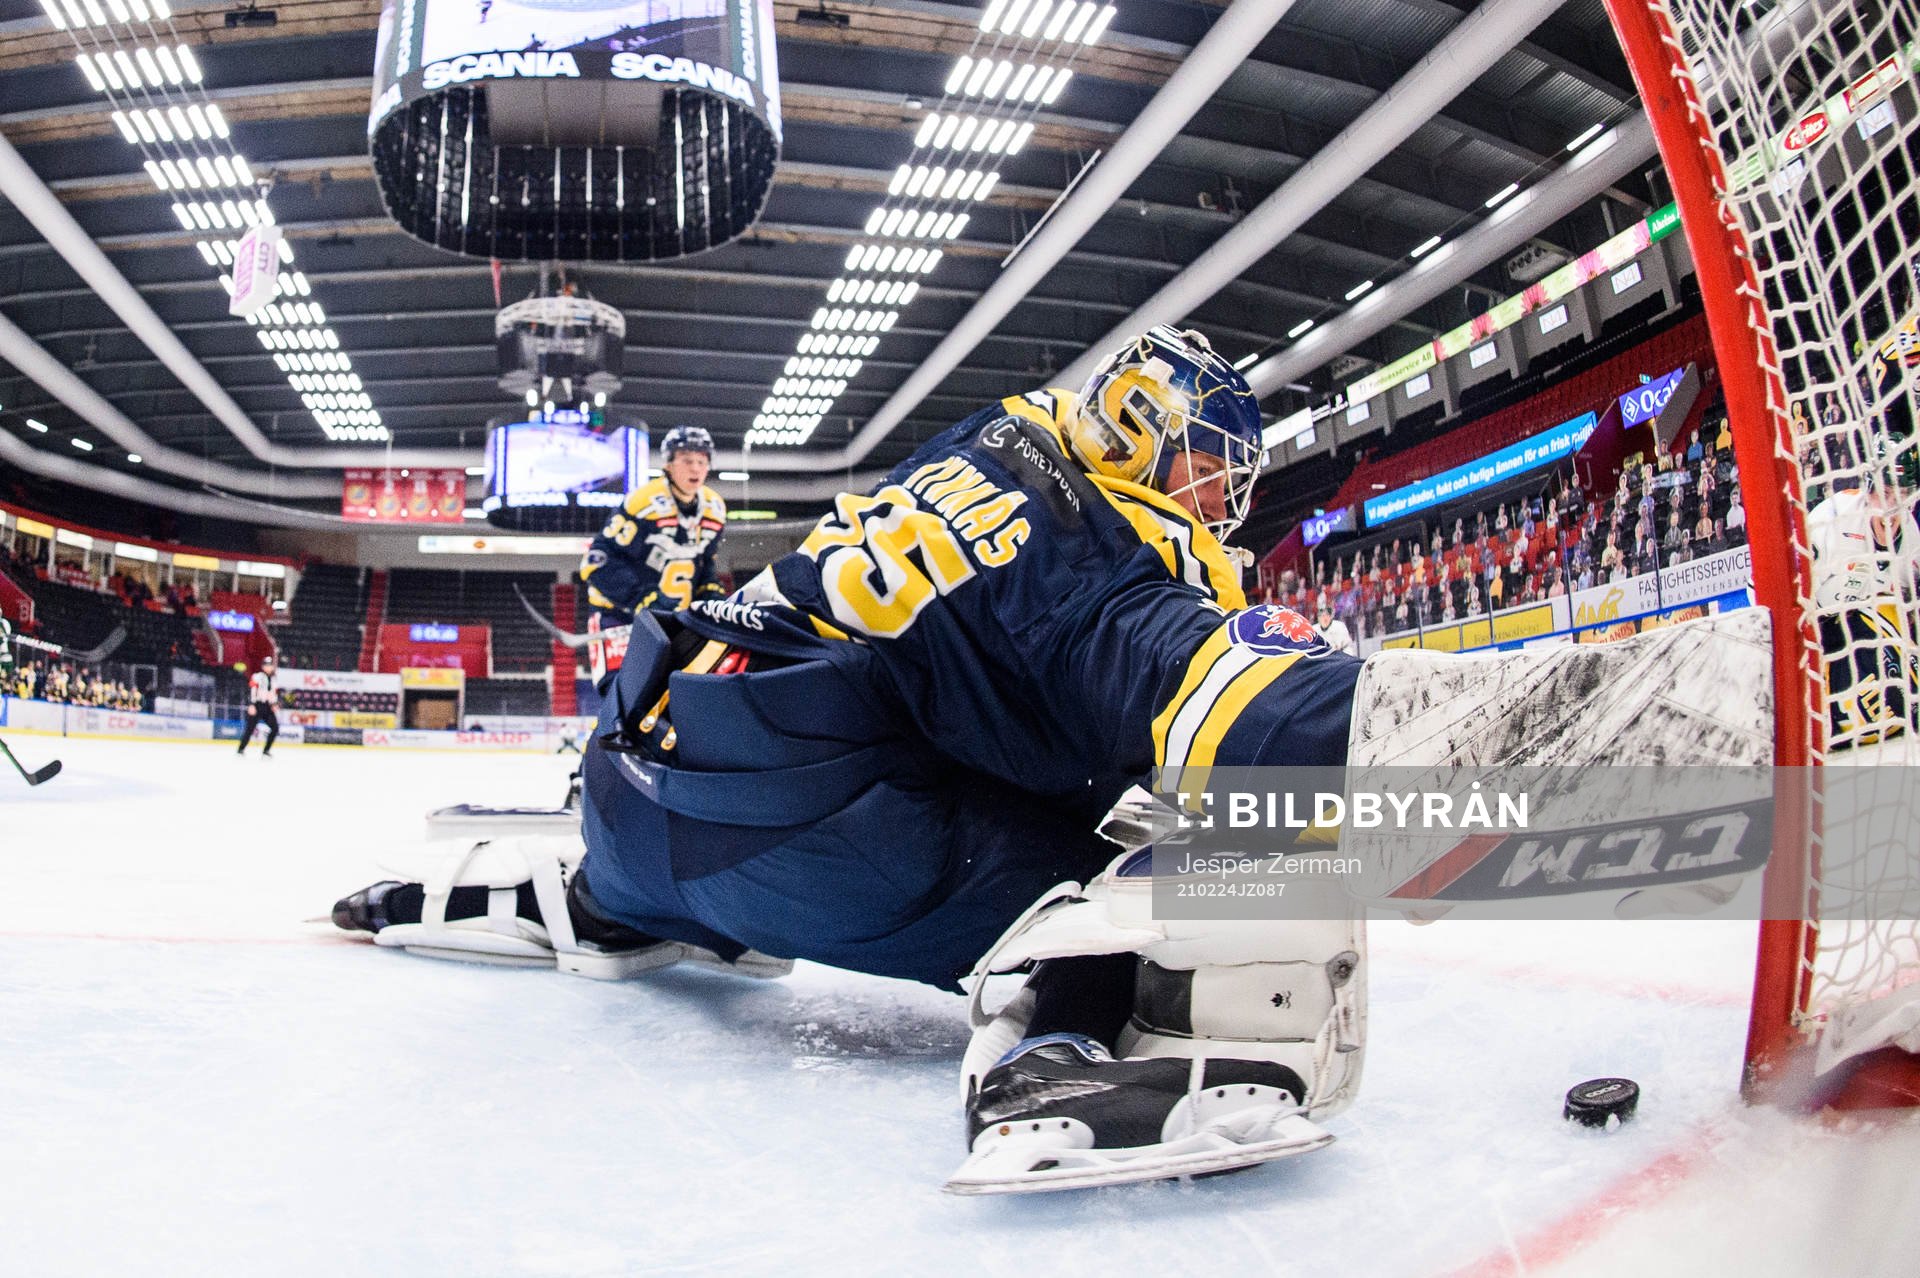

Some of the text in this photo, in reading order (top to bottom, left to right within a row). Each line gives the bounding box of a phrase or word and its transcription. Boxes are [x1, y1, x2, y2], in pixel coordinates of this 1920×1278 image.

[422, 51, 580, 90] SCANIA
[611, 51, 756, 108] SCANIA
[603, 514, 638, 546] 33
[456, 731, 532, 745] SHARP
